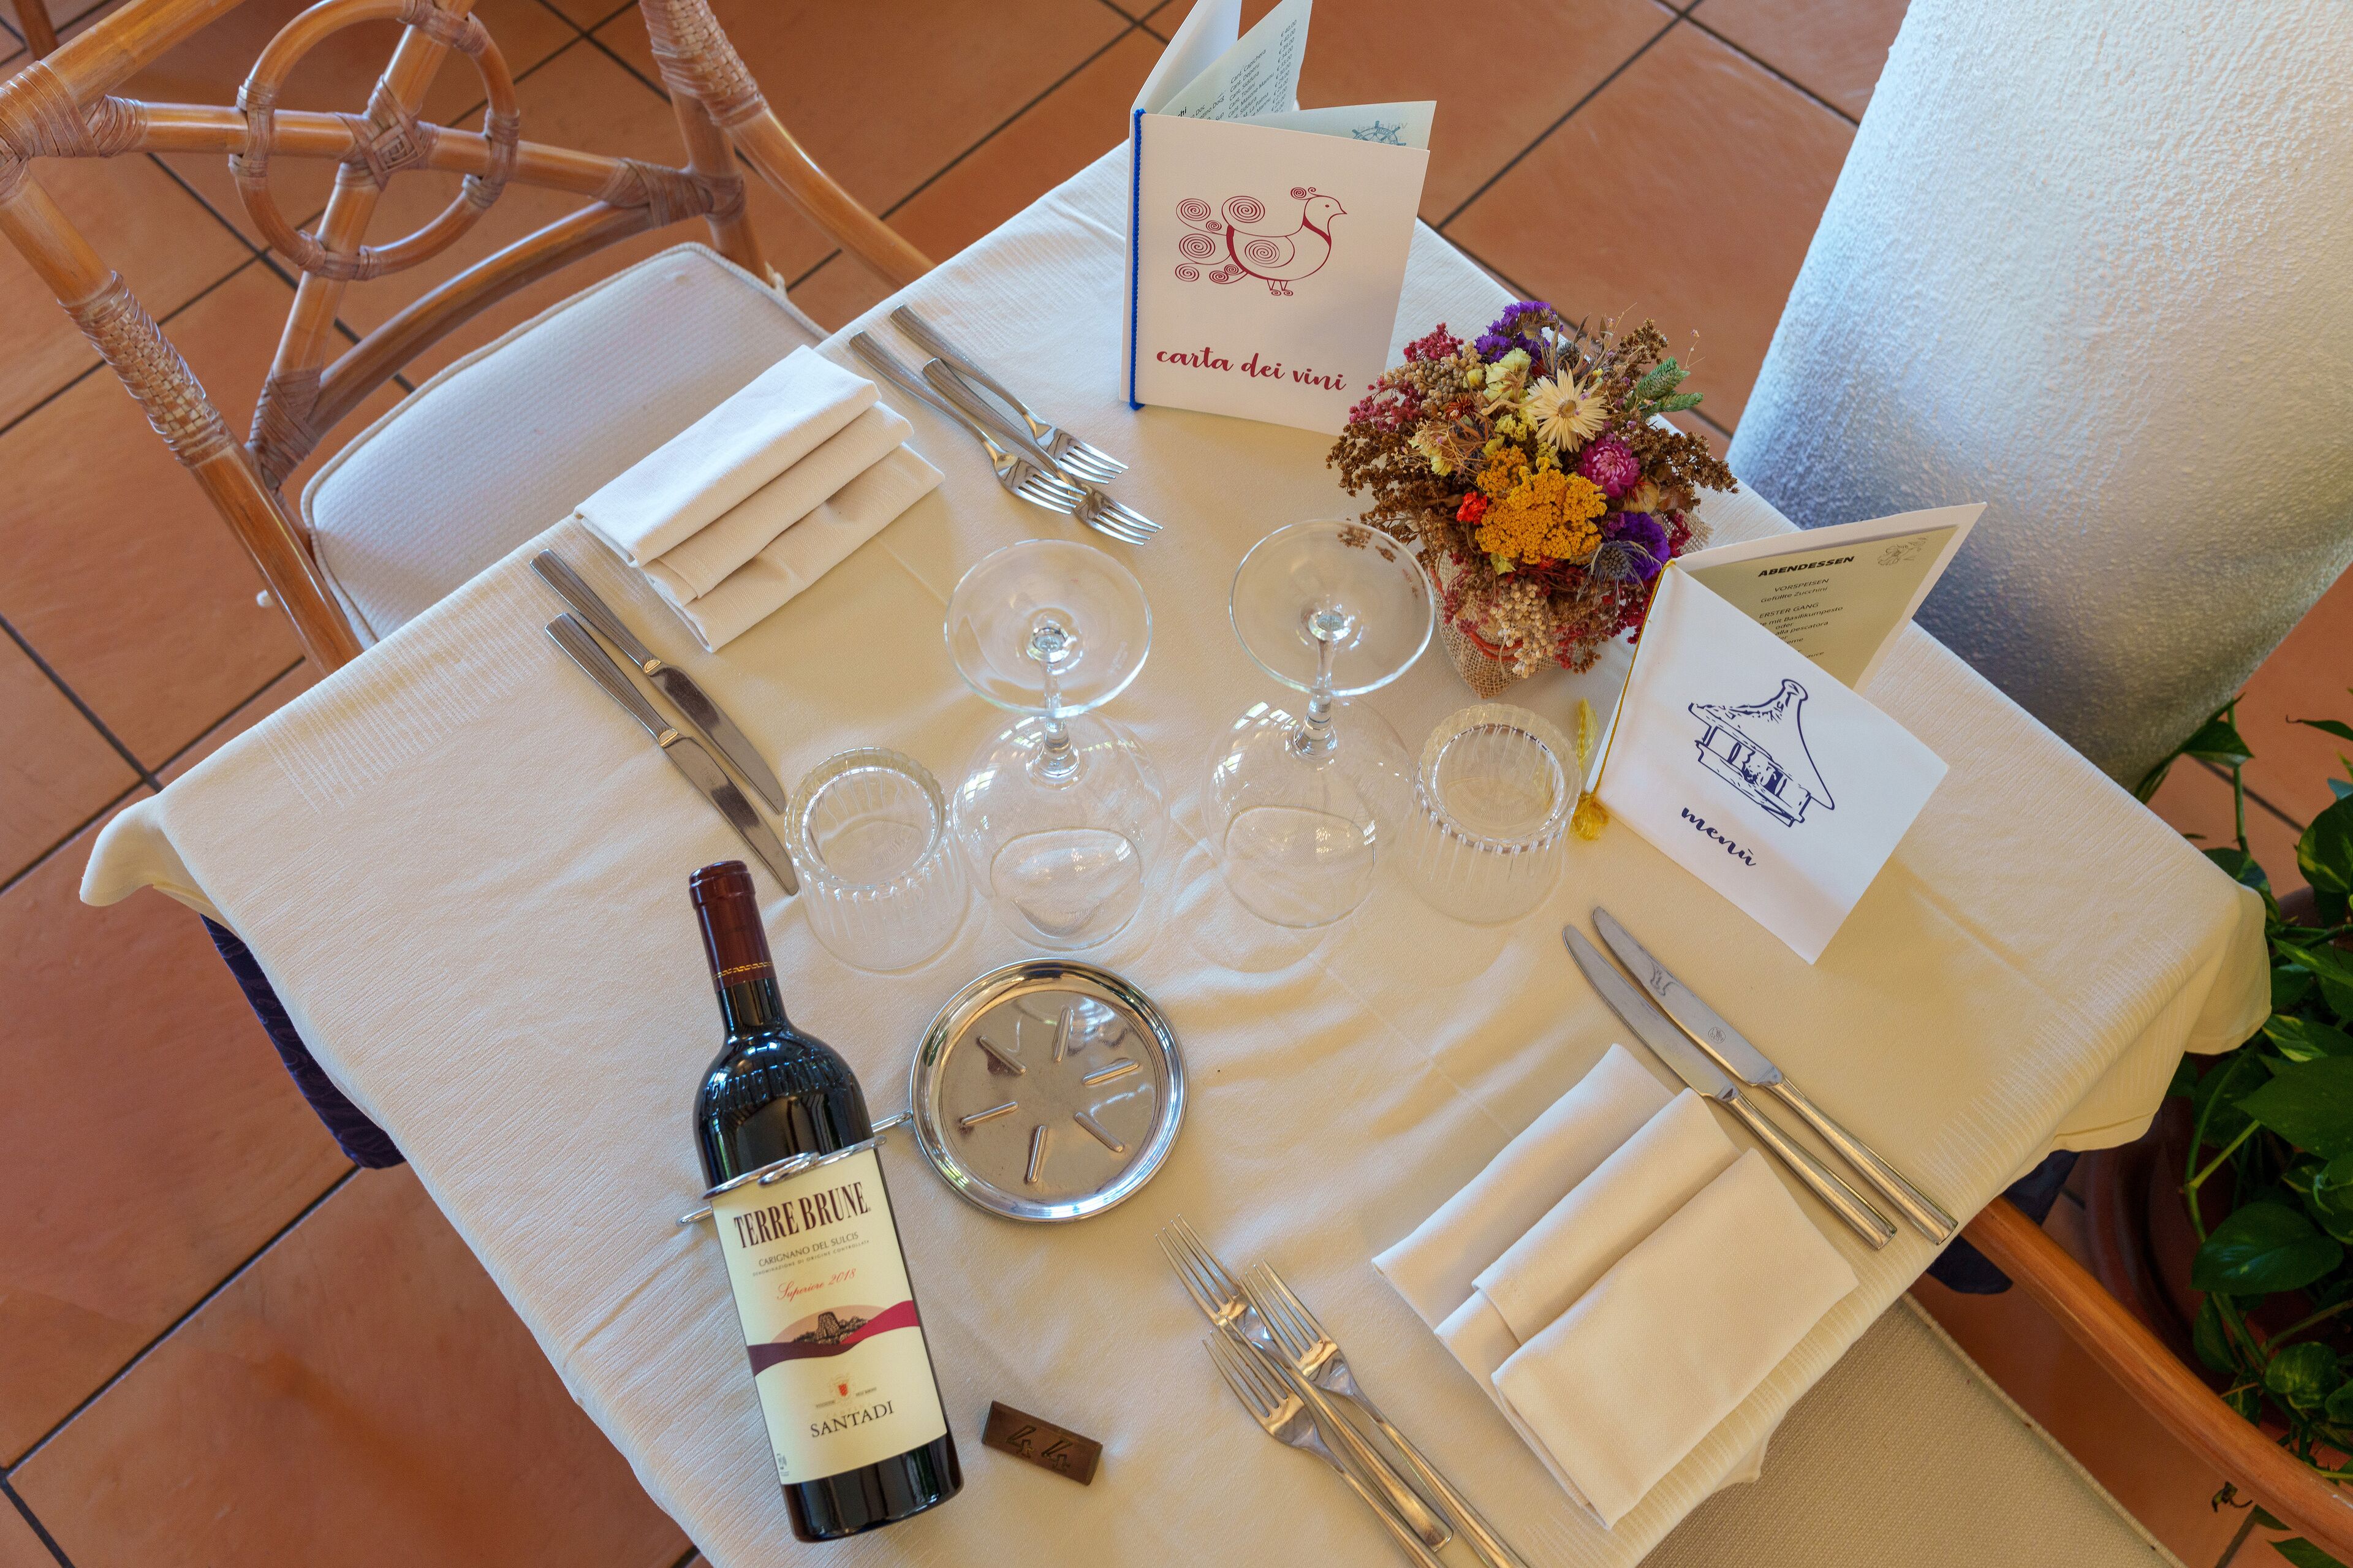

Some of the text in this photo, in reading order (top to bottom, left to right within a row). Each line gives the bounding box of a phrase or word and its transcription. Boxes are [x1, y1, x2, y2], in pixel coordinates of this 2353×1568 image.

[1230, 70, 1243, 83] Cant.
[1243, 50, 1266, 72] Capichera
[1284, 20, 1297, 33] 40.00
[1230, 80, 1241, 93] Cant.
[1243, 62, 1260, 81] Deperu
[1284, 28, 1295, 42] 40.00
[1229, 88, 1241, 101] Cant.
[1229, 97, 1240, 110] Cant.
[1228, 105, 1240, 118] Cant.
[1156, 347, 1346, 390] carta dei vini
[1758, 556, 1855, 577] ABENDESSEN
[1760, 586, 1828, 603] Gefüllte Zucchini
[1775, 578, 1829, 593] VORSPEISEN
[1759, 602, 1819, 619] ERSTER GANG
[1784, 606, 1843, 622] Basilikumpesto
[1790, 621, 1828, 634] pescatora
[733, 1182, 869, 1248] TERRE BRUNE
[759, 1231, 858, 1267] CARIGNANO DEL SULCIS
[806, 1252, 831, 1262] ORIGINE
[833, 1240, 870, 1254] CONTROLLATA
[776, 1268, 857, 1302] Superiore 2018
[810, 1400, 894, 1437] SANTADI
